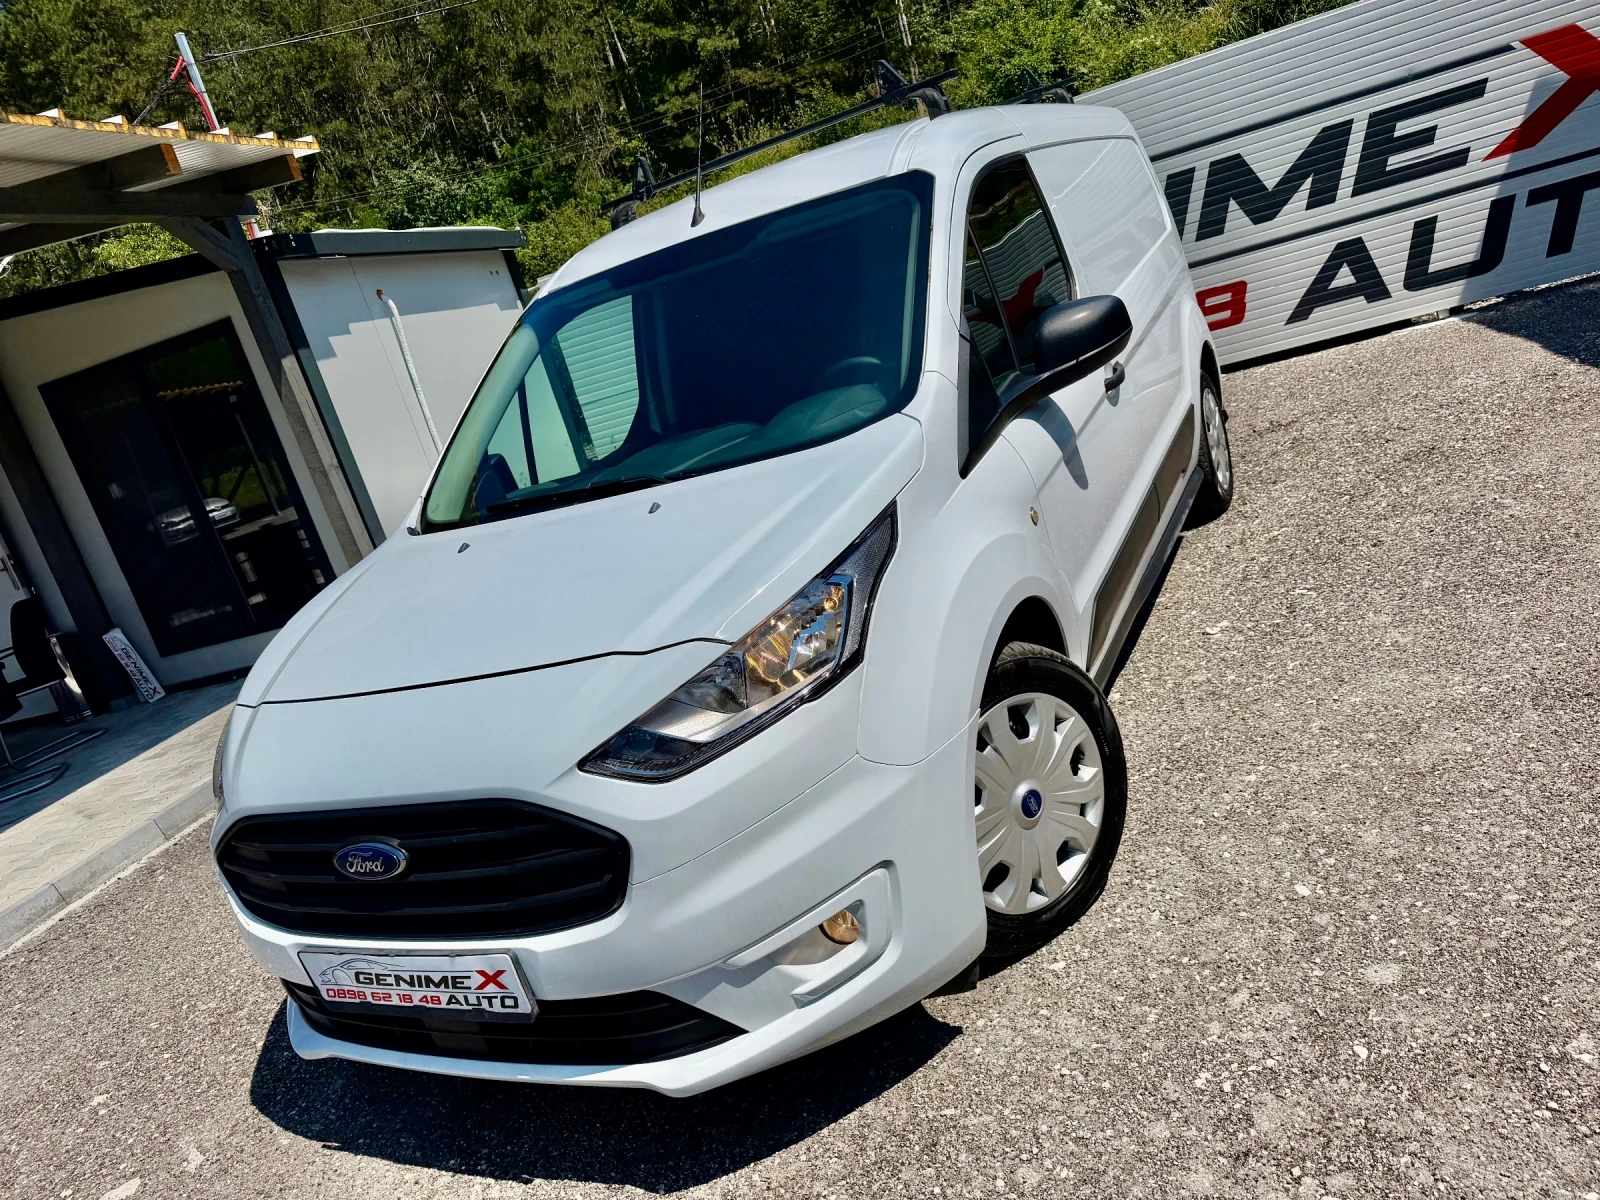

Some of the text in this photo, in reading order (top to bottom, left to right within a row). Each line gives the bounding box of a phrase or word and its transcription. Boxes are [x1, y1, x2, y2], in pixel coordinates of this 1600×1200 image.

[121, 648, 161, 695] GENIMEX
[134, 678, 154, 699] AUTO
[346, 851, 385, 873] Ford
[354, 969, 509, 990] GENIMEX
[326, 988, 519, 1009] 0898 62 18 48 AUTO
